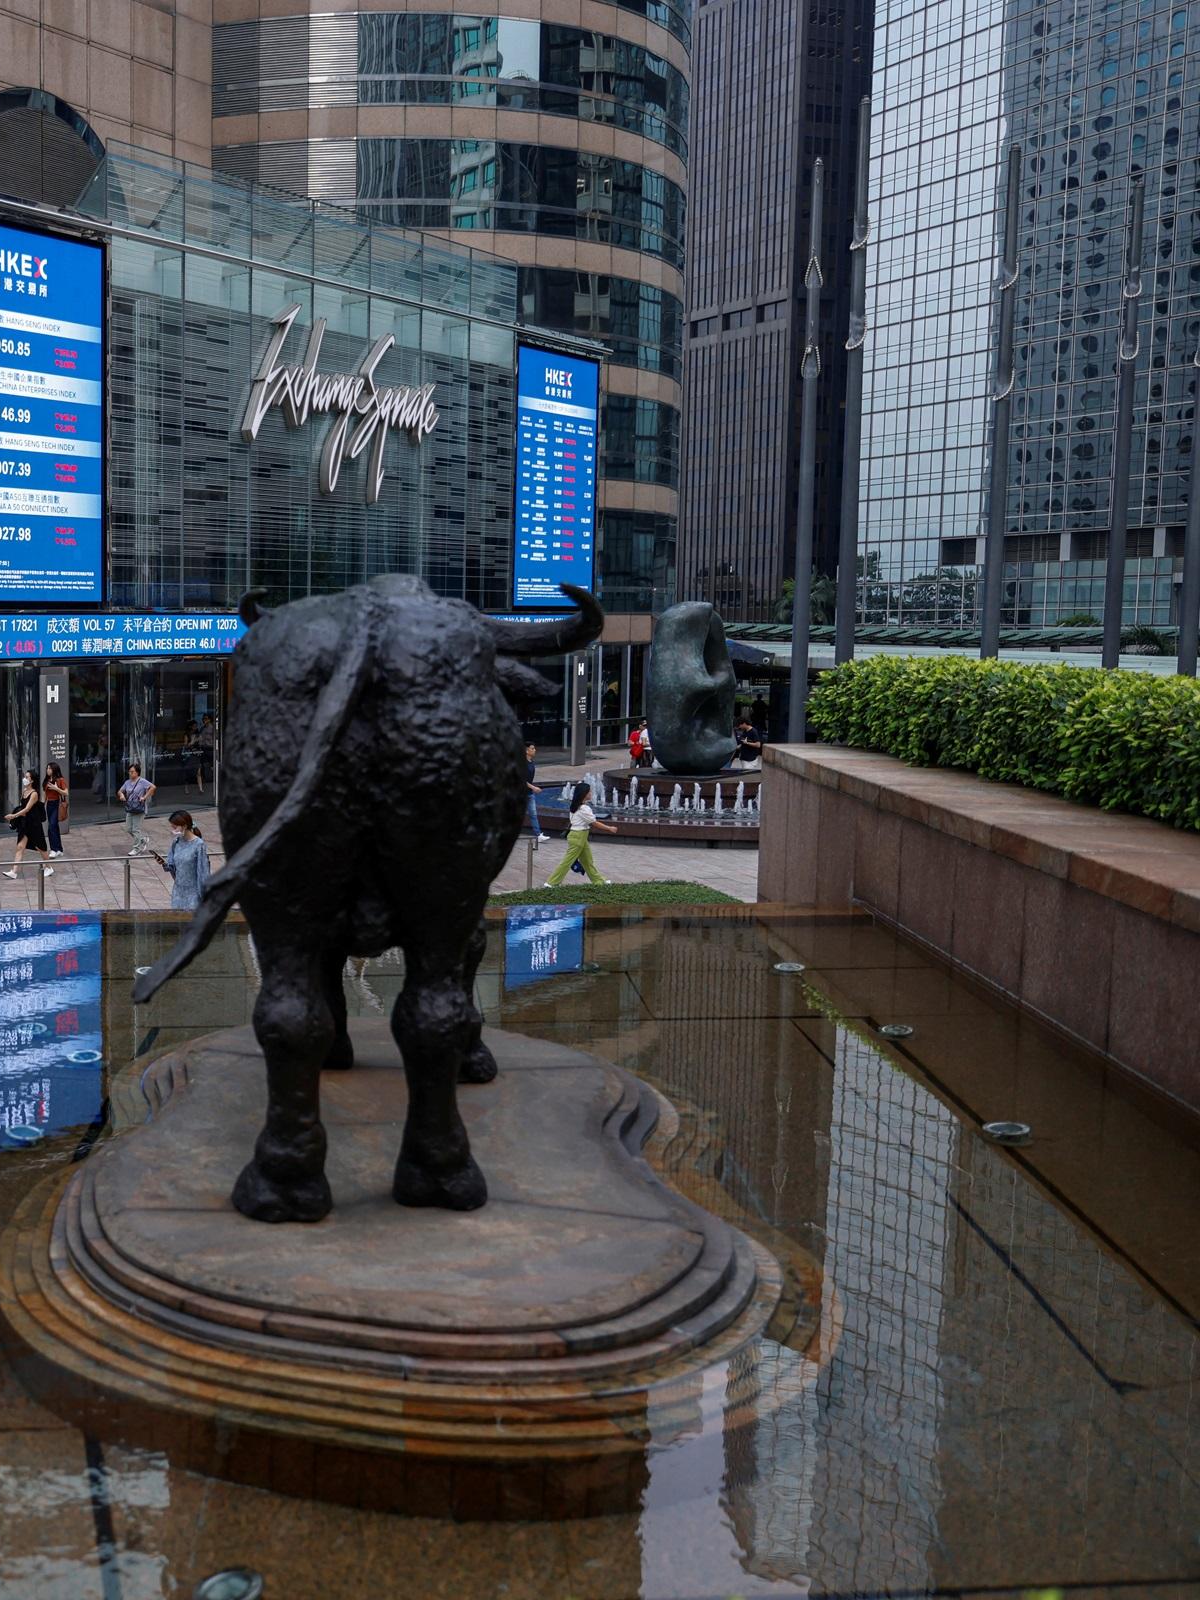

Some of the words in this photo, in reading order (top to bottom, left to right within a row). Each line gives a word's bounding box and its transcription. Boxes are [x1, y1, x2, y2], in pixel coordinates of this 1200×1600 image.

[6, 316, 24, 326] HANG
[25, 320, 41, 330] SENG
[42, 323, 61, 332] INDEX
[545, 368, 572, 387] HKEX
[19, 384, 58, 396] ENTERPRISES
[59, 390, 77, 399] INDEX
[5, 438, 23, 447] HANG
[24, 440, 40, 448] SENG
[41, 441, 56, 450] TECH
[58, 443, 75, 451] INDEX
[21, 504, 49, 513] CONNECT
[11, 619, 37, 632] 17821
[47, 618, 79, 634] 成交額
[83, 619, 101, 631] VOL
[105, 619, 115, 631] 57
[122, 617, 172, 633] 未平倉合約
[176, 619, 199, 630] OPEN
[200, 619, 213, 630] INT
[216, 619, 237, 630] 12073
[52, 640, 77, 652] 00291
[81, 638, 123, 654] 華潤啤酒
[126, 639, 154, 651] CHINA
[156, 639, 172, 650] RES
[174, 638, 196, 650] BEER
[199, 638, 215, 648] 46.0
